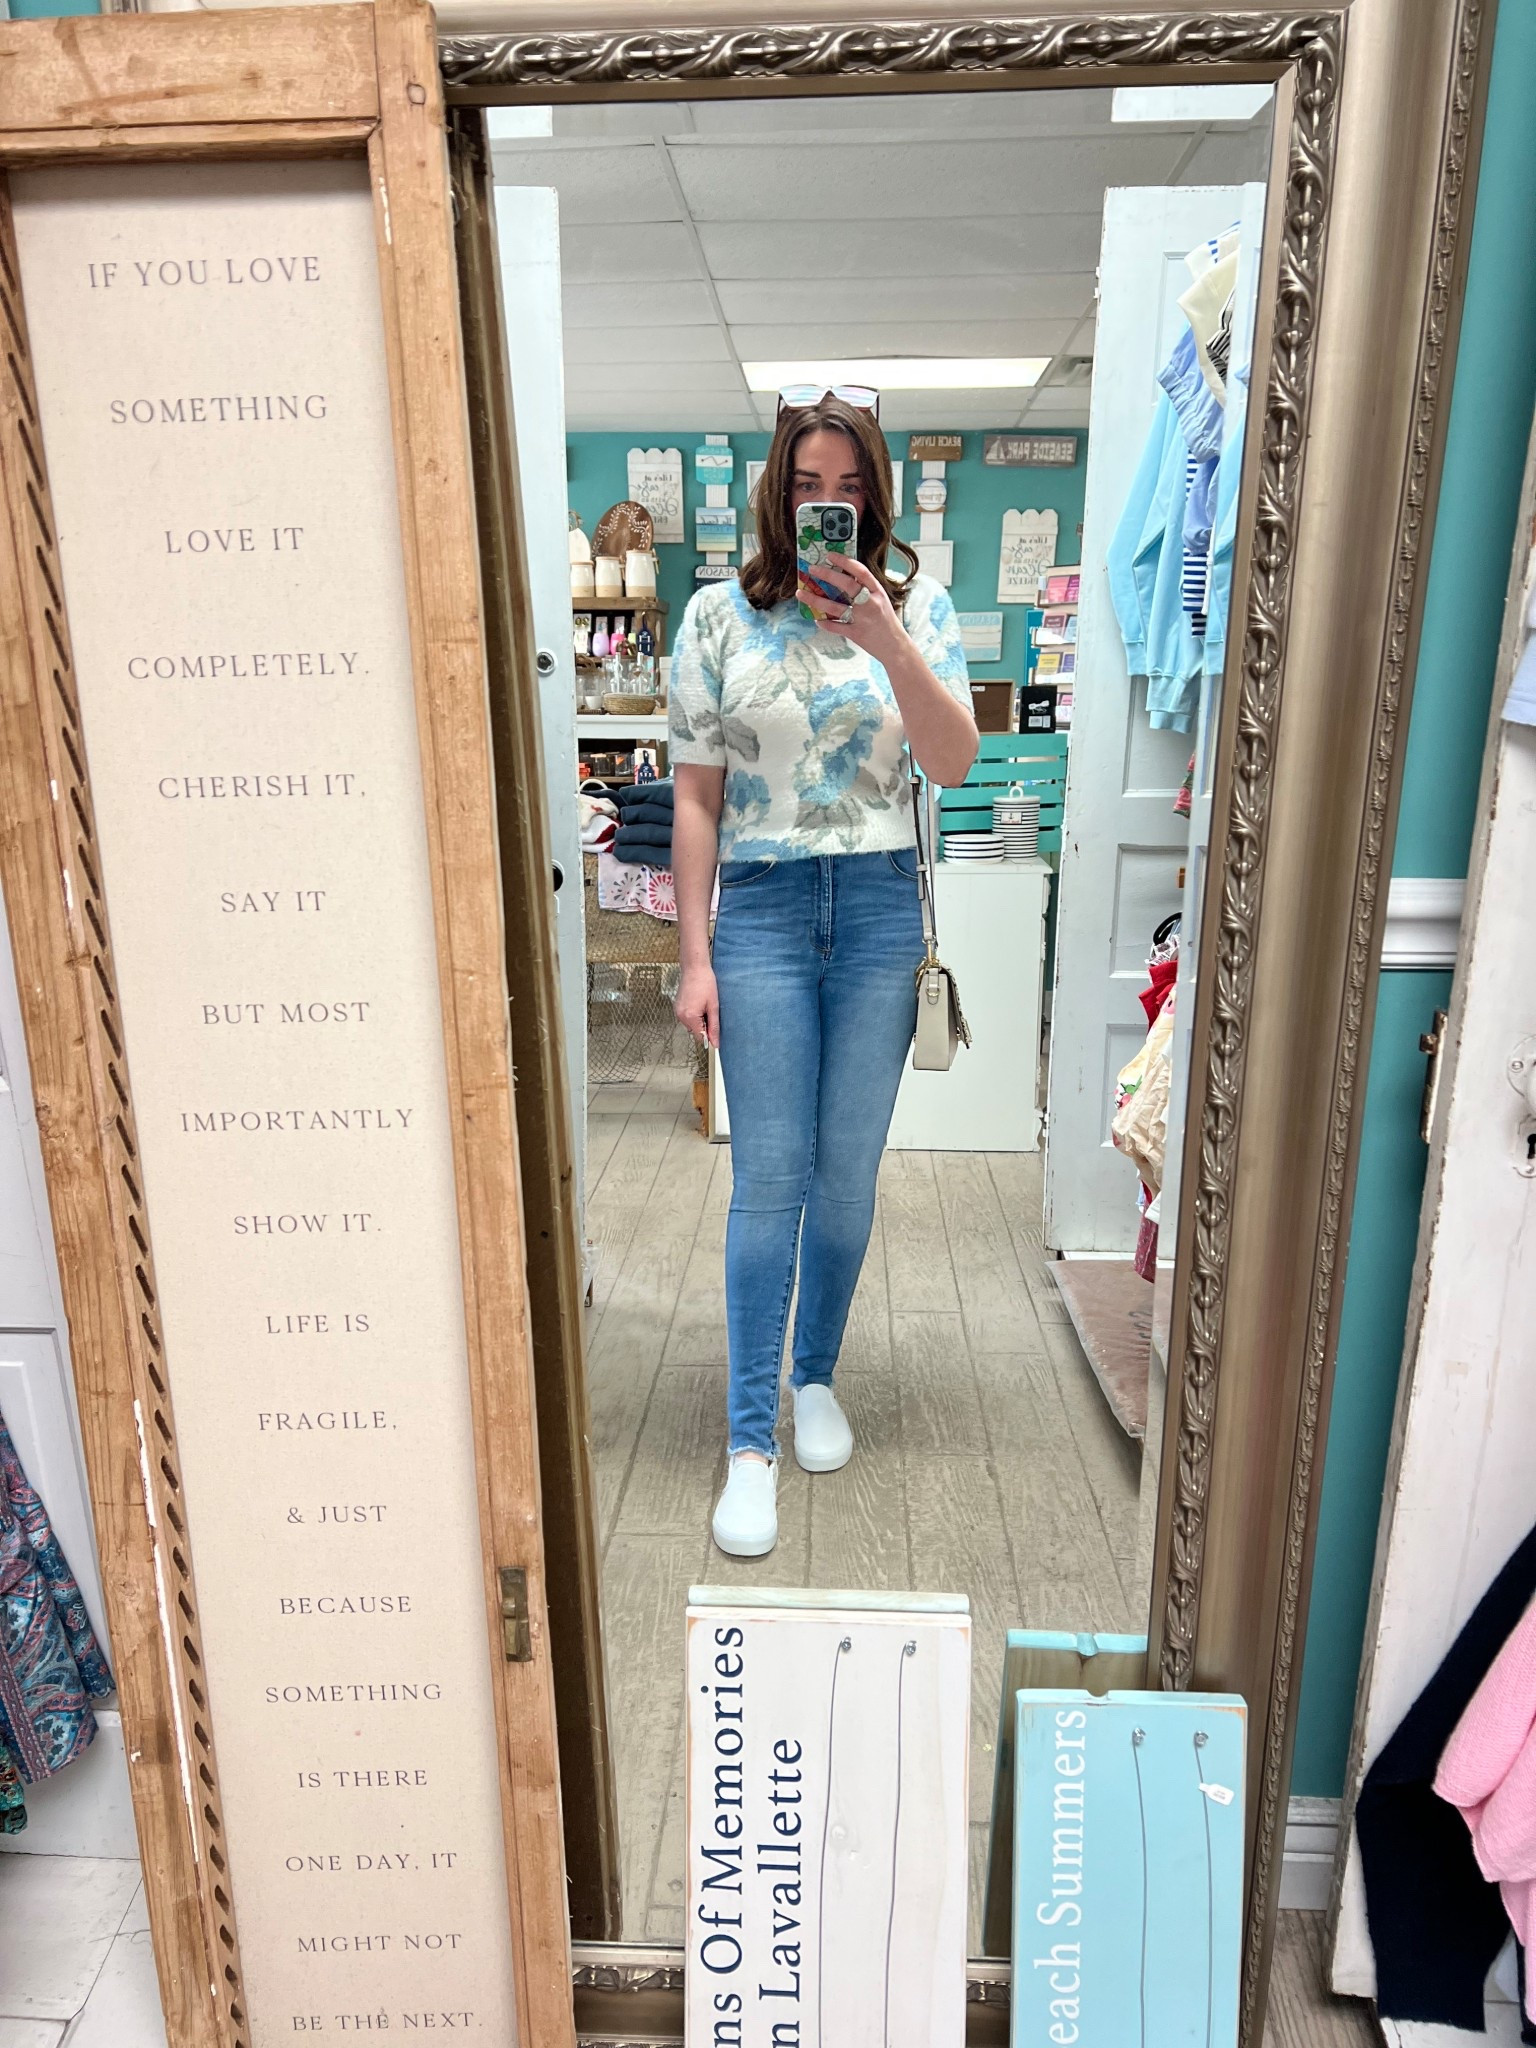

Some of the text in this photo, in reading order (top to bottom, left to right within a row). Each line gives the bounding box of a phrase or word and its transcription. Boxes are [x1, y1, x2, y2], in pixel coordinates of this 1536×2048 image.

[87, 256, 321, 289] IF YOU LOVE
[110, 394, 328, 424] SOMETHING
[165, 527, 305, 554] LOVE IT
[127, 651, 370, 680] COMPLETELY.
[158, 773, 366, 799] CHERISH IT,
[220, 890, 327, 913] SAY IT
[201, 1001, 371, 1025] BUT MOST
[180, 1108, 414, 1132] IMPORTANTLY
[233, 1213, 383, 1235] SHOW IT.
[265, 1313, 371, 1335] LIFE IS
[257, 1410, 398, 1432] FRAGILE,
[286, 1504, 388, 1525] & JUST
[279, 1595, 412, 1615] BECAUSE
[265, 1683, 443, 1704] SOMETHING
[700, 1626, 745, 1895] Memories
[297, 1769, 428, 1789] IS THERE
[1036, 1710, 1087, 1926] Summers
[285, 1852, 458, 1872] ONE DAY, IT
[757, 1739, 803, 2003] Lavallette
[297, 1933, 462, 1953] MIGHT NOT
[698, 1905, 743, 1974] Of
[292, 2011, 483, 2031] BE THE NEXT.
